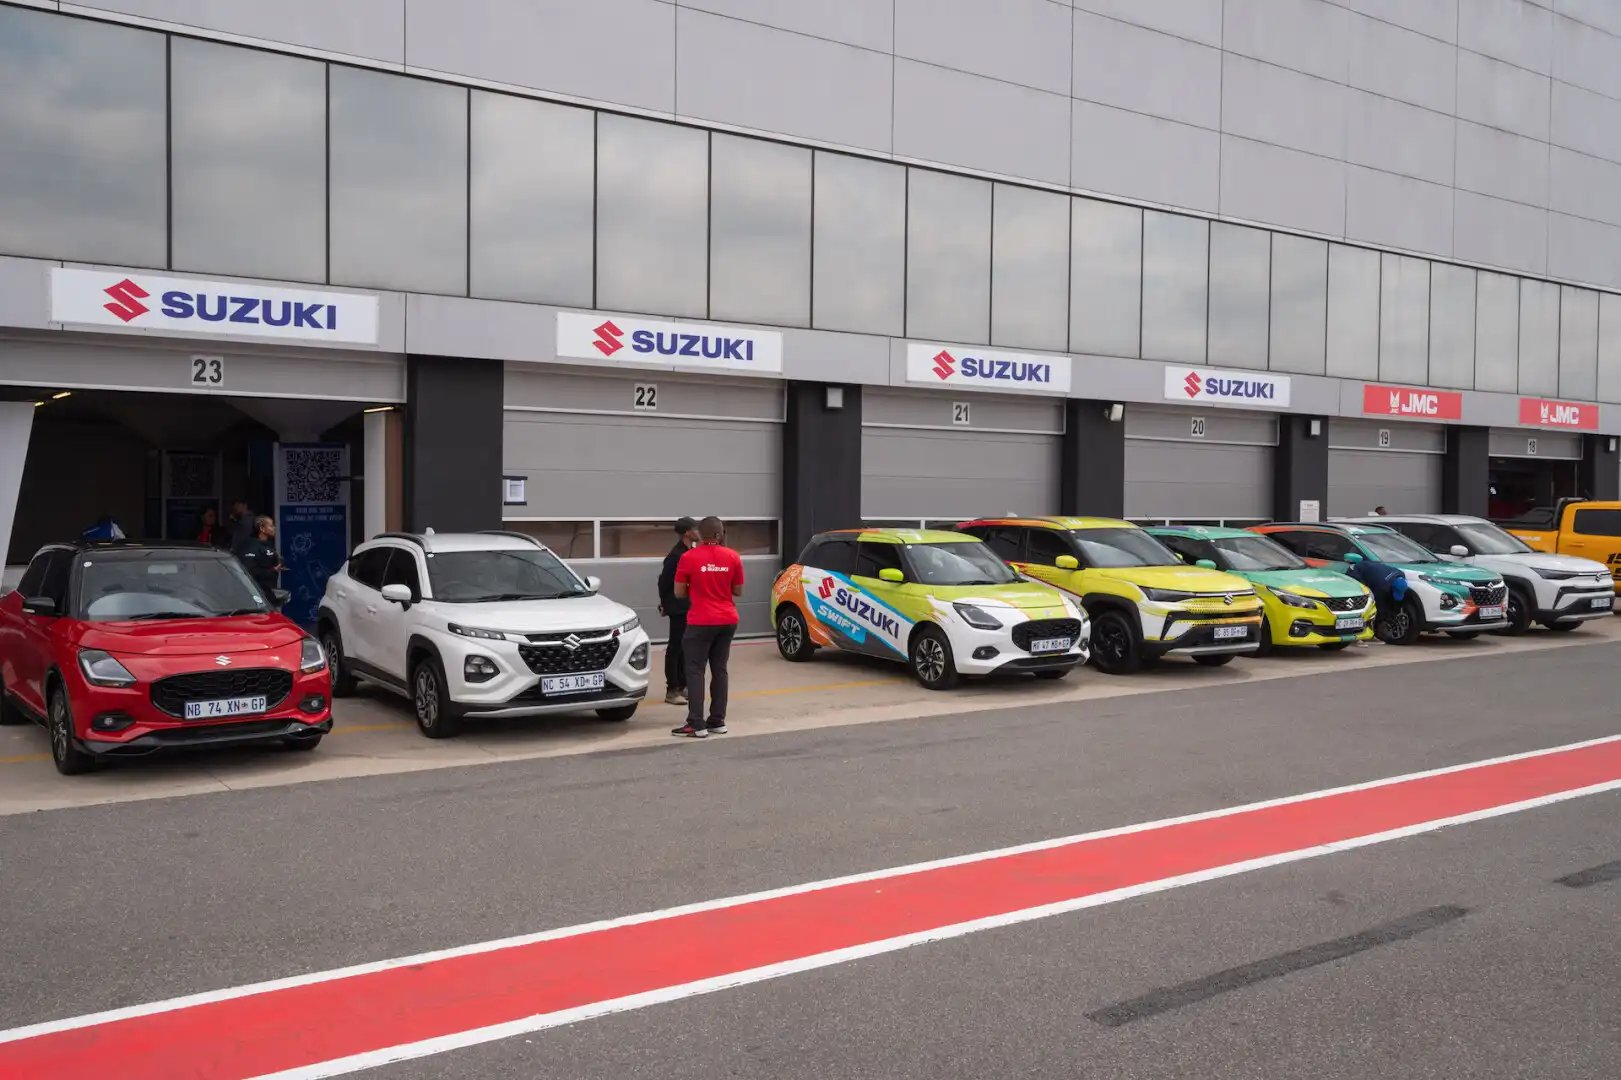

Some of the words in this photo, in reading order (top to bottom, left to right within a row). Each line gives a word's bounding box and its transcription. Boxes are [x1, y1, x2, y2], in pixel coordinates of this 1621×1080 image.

[161, 291, 337, 330] SUZUKI
[632, 329, 754, 361] SUZUKI
[192, 358, 223, 383] 23
[961, 357, 1050, 383] SUZUKI
[635, 387, 656, 407] 22
[1205, 377, 1274, 399] SUZUKI
[954, 404, 969, 422] 21
[1401, 392, 1438, 415] JMC
[1550, 404, 1580, 425] JMC
[1192, 419, 1205, 435] 20
[1380, 429, 1390, 445] 19
[1528, 439, 1538, 453] 18
[817, 604, 860, 635] SWIFT
[835, 588, 899, 640] SUZUKI
[543, 679, 554, 690] NC
[559, 678, 570, 689] 54
[574, 676, 585, 688] XD
[593, 674, 604, 686] GP
[187, 704, 201, 717] NB
[208, 702, 222, 715] 74
[226, 700, 240, 712] XN
[251, 698, 264, 710] GP
